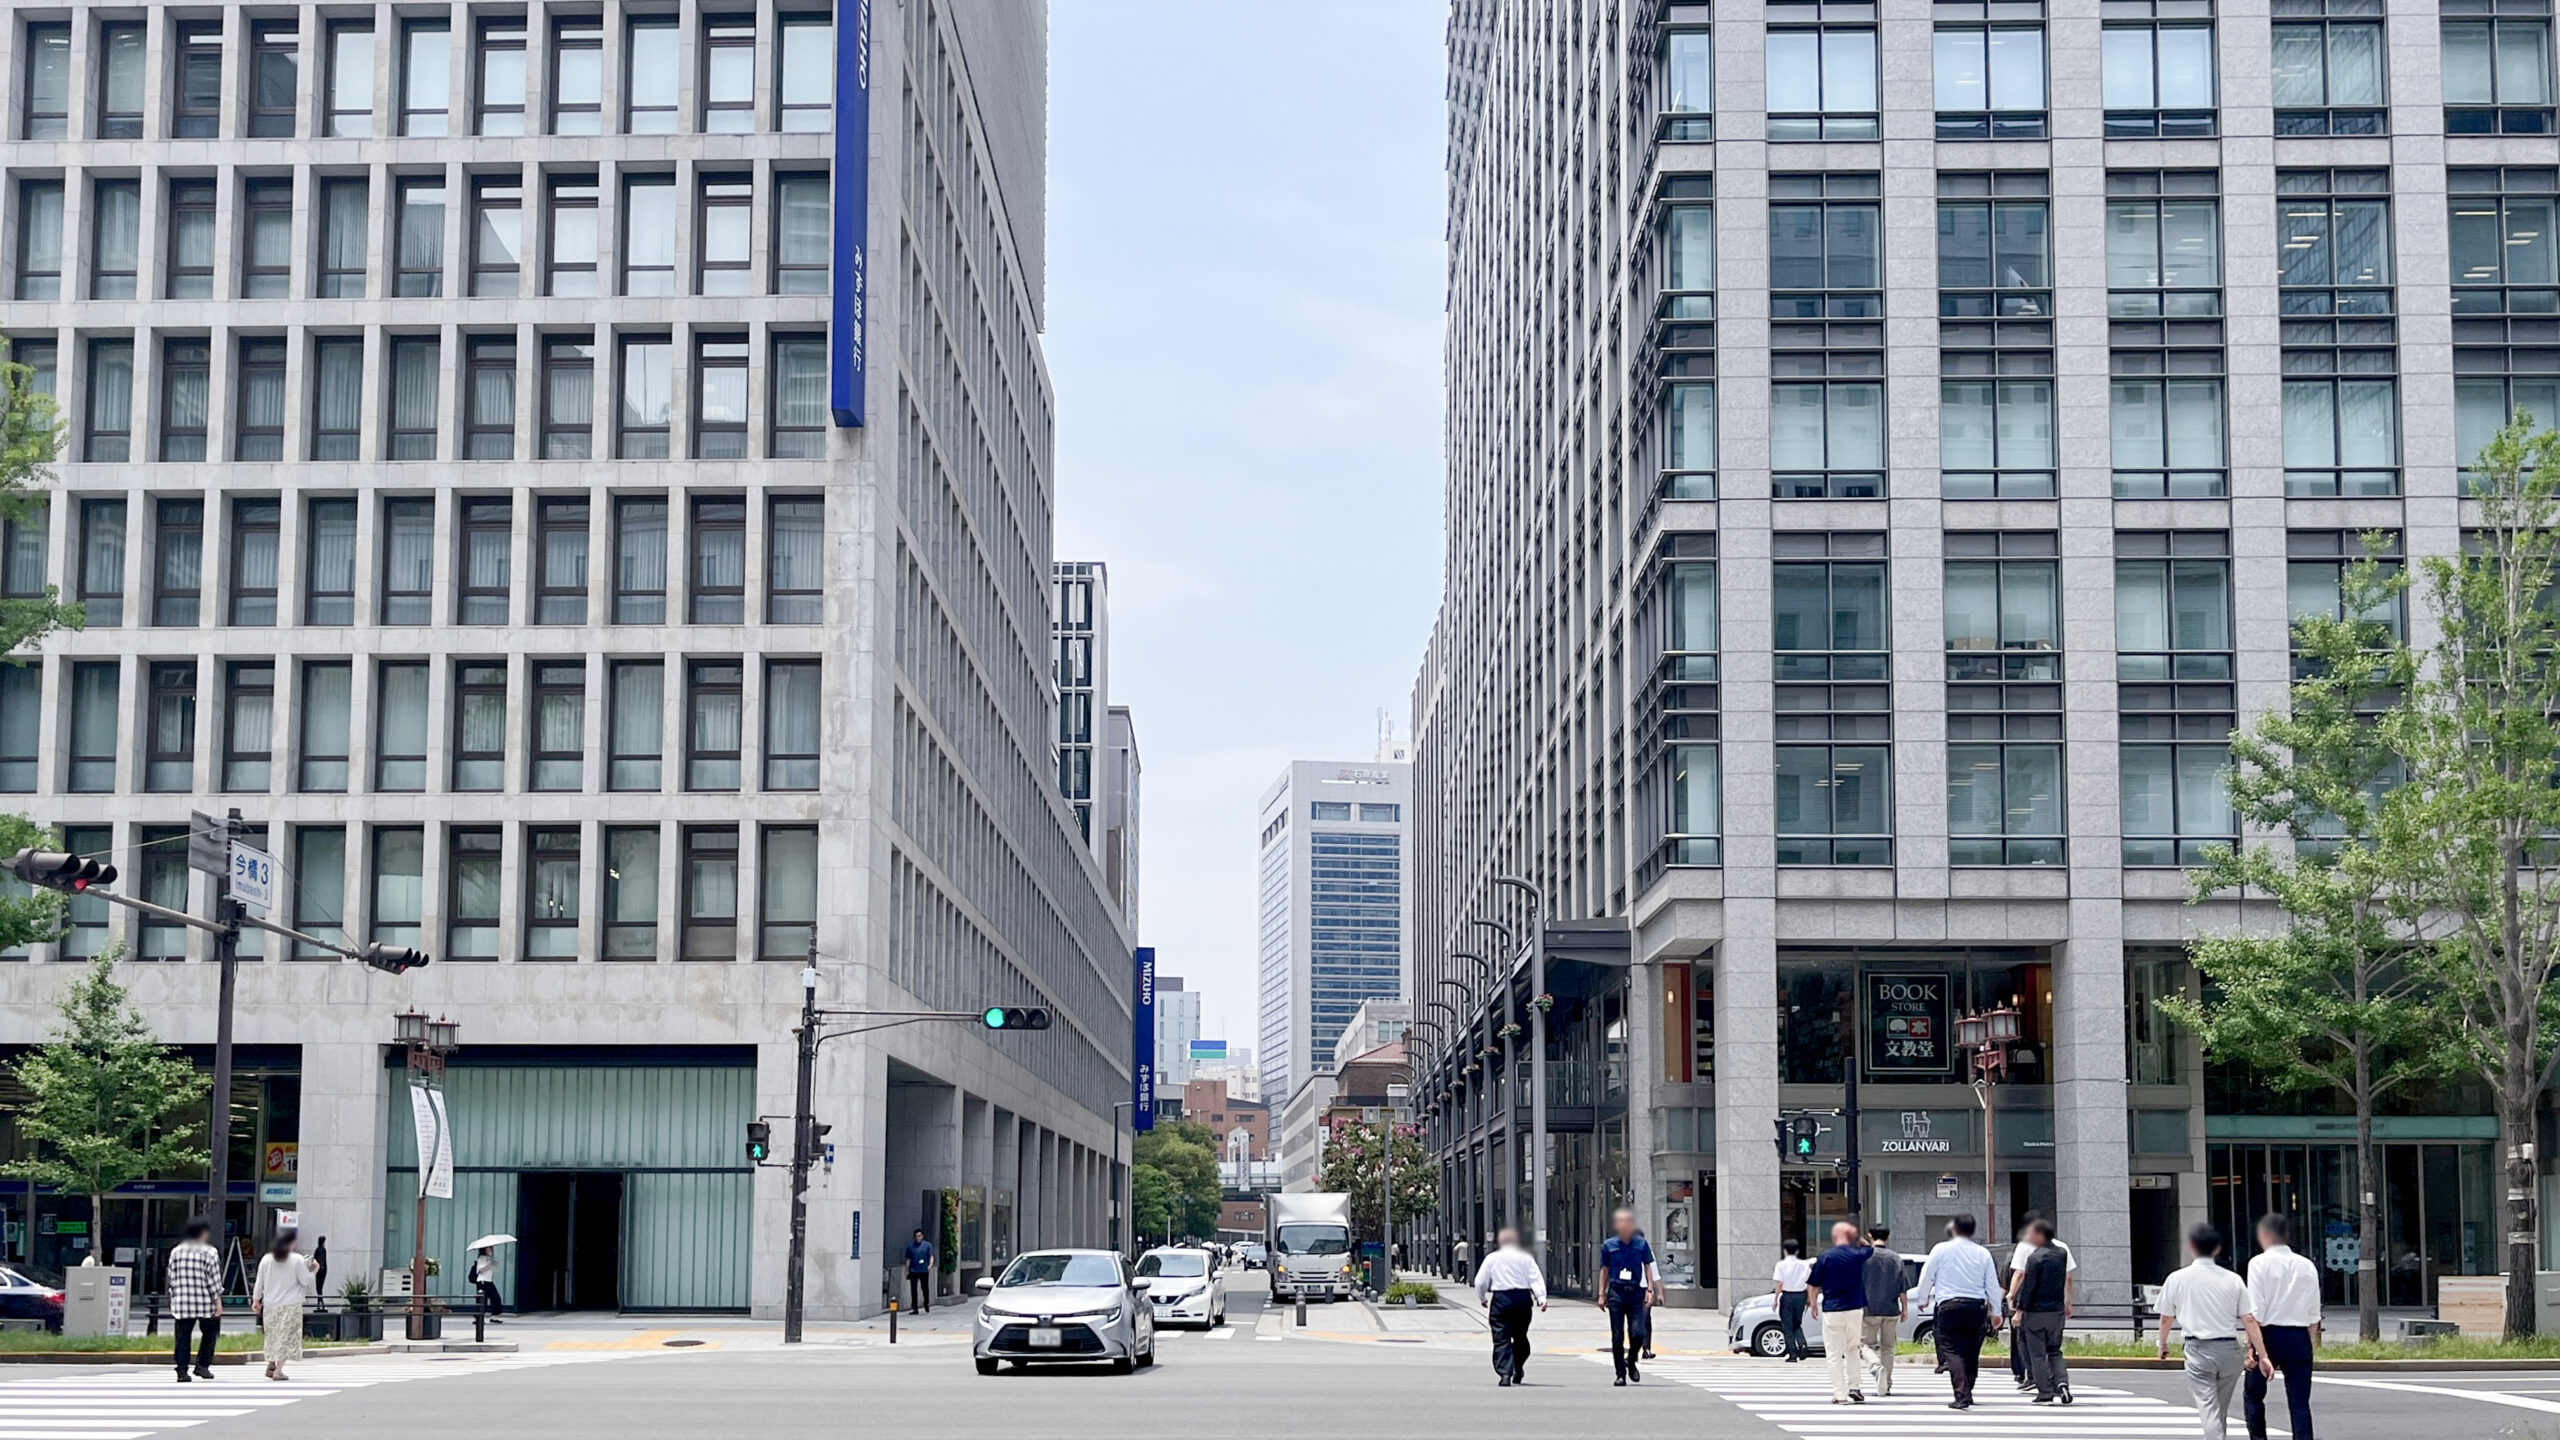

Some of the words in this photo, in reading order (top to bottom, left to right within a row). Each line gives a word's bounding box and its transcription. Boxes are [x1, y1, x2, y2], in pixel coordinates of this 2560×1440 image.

[1142, 961, 1153, 1006] MIZUHO
[1879, 984, 1938, 1000] BOOK
[1891, 1002, 1926, 1012] STORE
[1885, 1040, 1934, 1057] 文教堂
[1140, 1064, 1149, 1112] みずほ銀行
[1881, 1141, 1950, 1152] ZOLLANVARI
